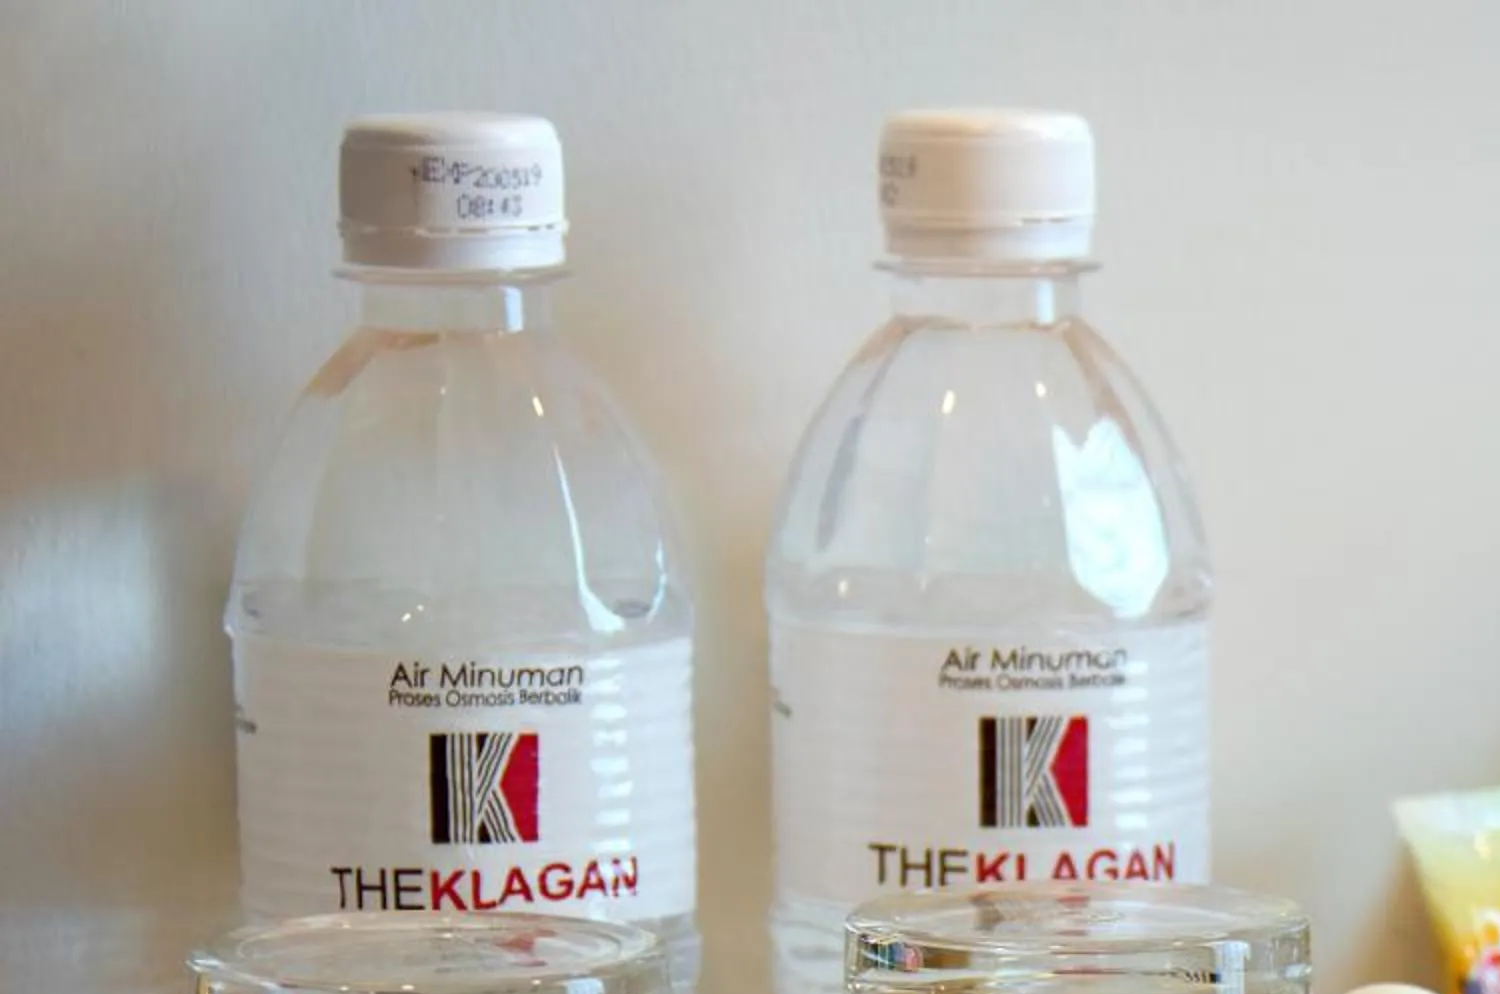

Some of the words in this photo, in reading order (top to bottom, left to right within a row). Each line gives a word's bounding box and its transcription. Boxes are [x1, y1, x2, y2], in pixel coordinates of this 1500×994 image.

[941, 646, 981, 671] Air
[991, 645, 1127, 671] Minuman
[390, 662, 430, 688] Air
[440, 661, 584, 688] Minuman
[388, 688, 441, 708] Proses
[445, 688, 515, 708] Osmosis
[519, 687, 583, 706] Berbalik
